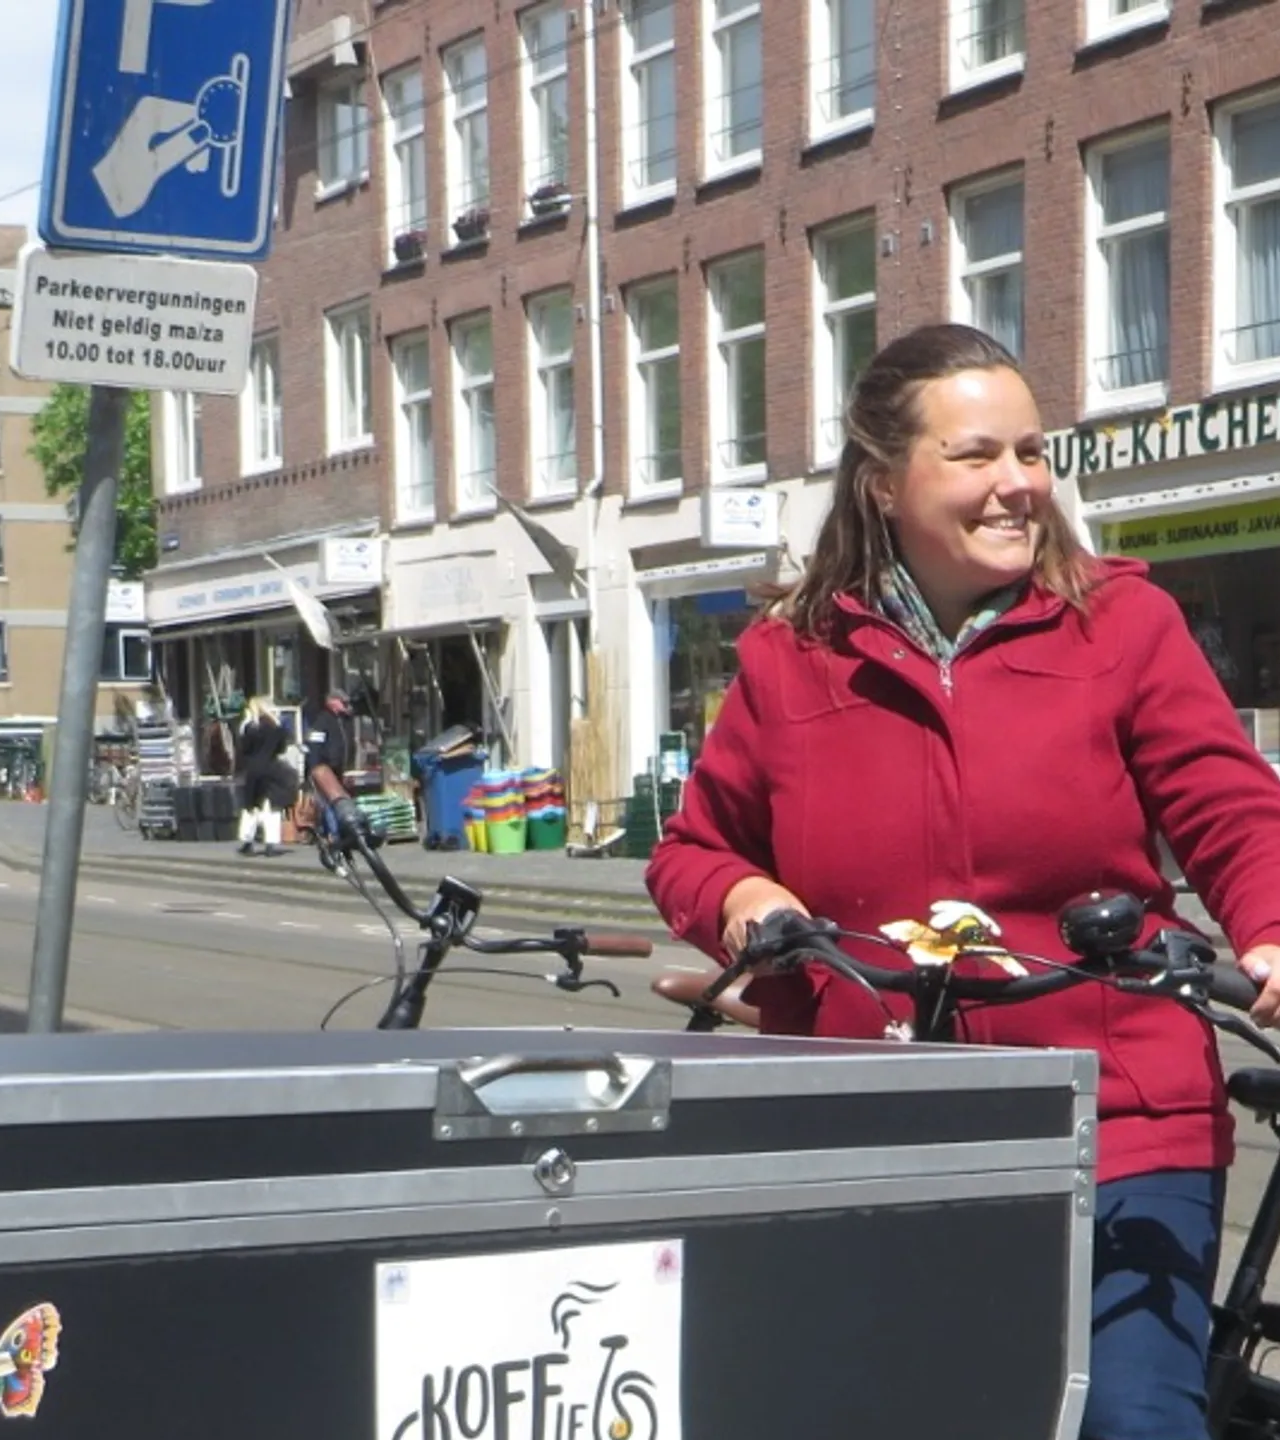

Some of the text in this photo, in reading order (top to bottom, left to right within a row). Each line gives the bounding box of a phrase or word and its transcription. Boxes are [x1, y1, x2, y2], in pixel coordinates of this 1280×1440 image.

[36, 276, 246, 316] Parkeervergunningen
[53, 309, 225, 342] Niet geldig ma/za
[45, 340, 227, 373] 10.00 tot 18.00uur
